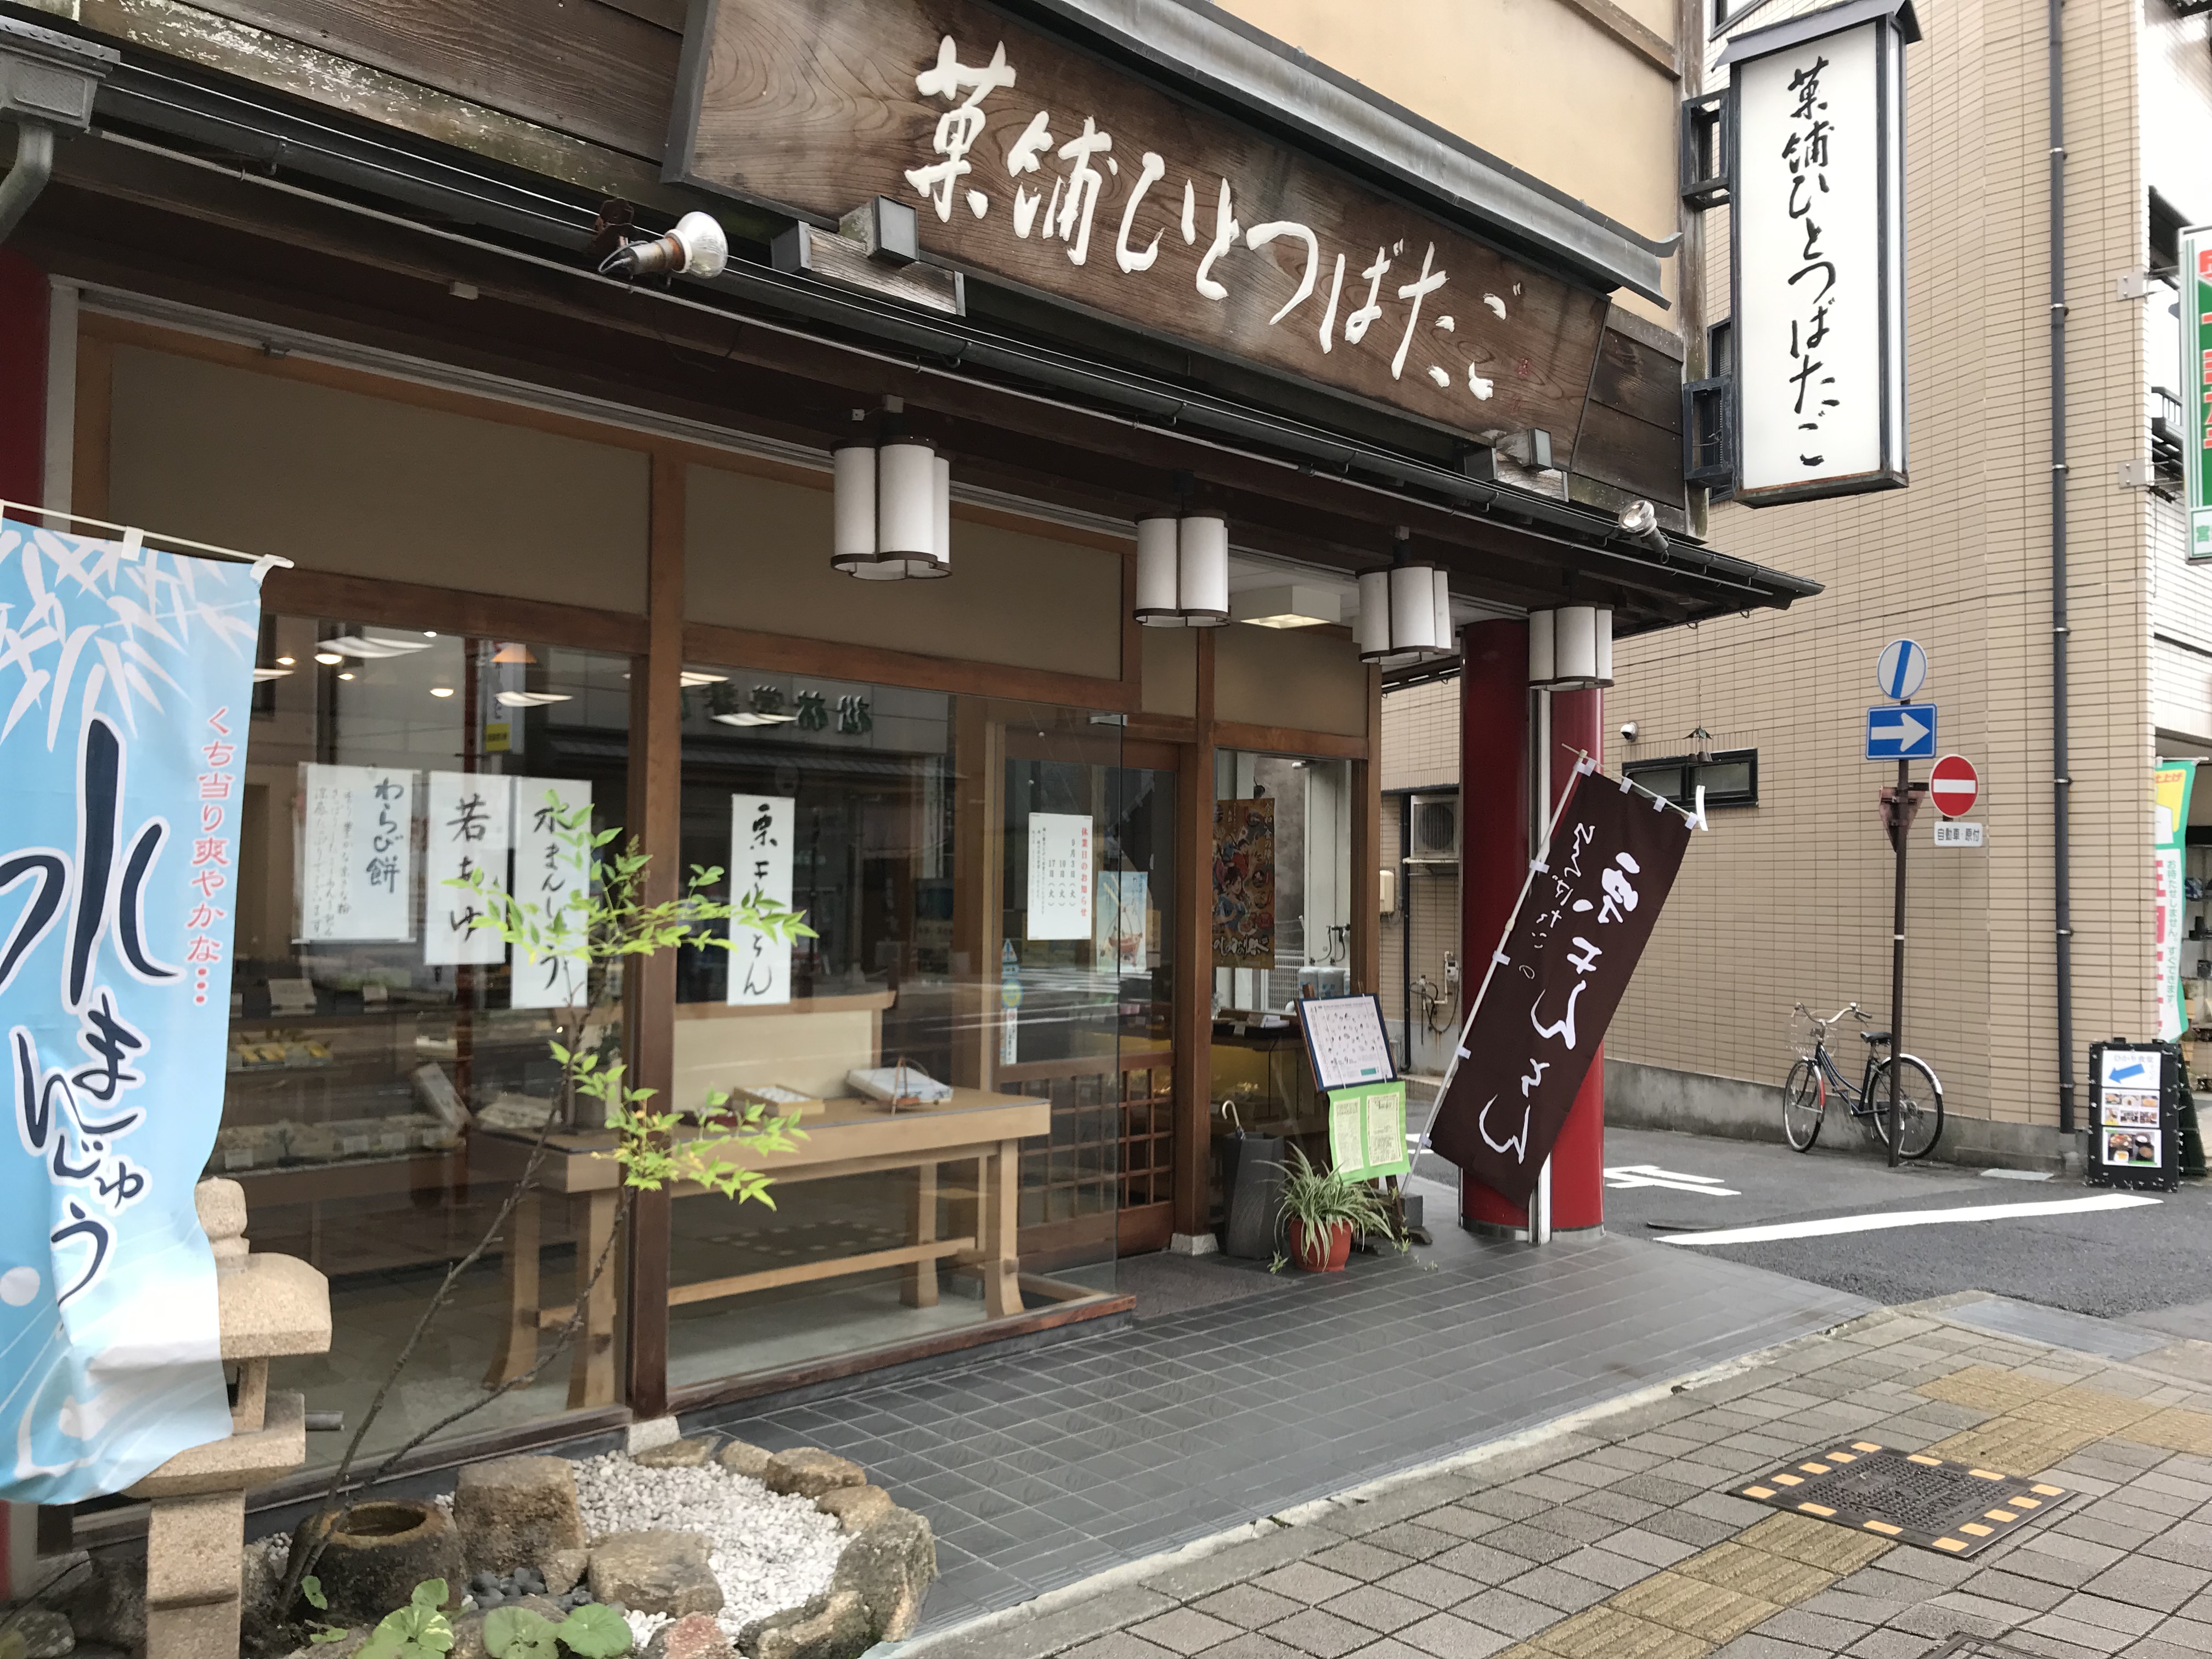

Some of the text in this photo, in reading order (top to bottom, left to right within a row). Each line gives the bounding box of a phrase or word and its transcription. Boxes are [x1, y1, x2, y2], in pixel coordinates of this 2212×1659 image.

[1782, 55, 1839, 467] 菓舗ひとつばたご
[366, 776, 405, 894] わらび餅
[1080, 827, 1088, 917] 休業日のお知らせ
